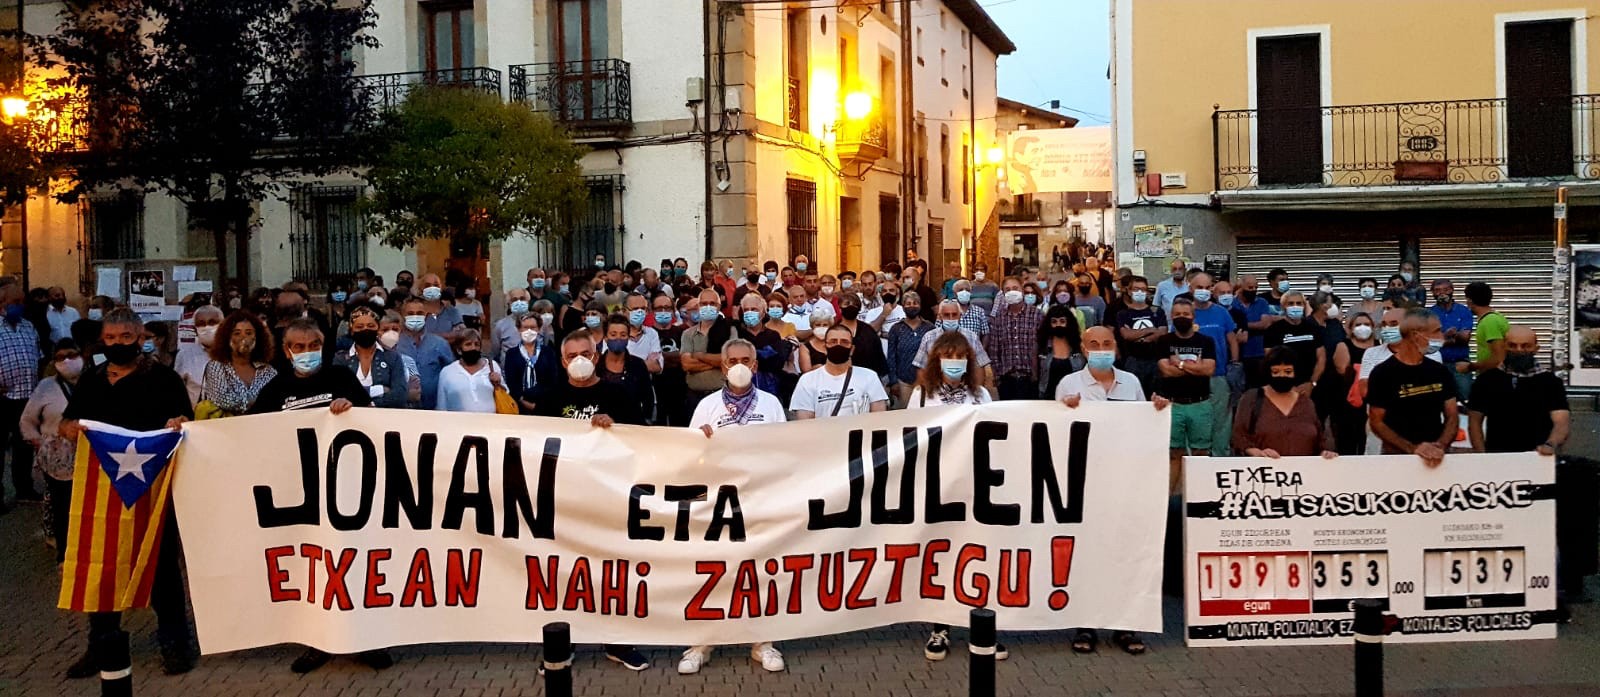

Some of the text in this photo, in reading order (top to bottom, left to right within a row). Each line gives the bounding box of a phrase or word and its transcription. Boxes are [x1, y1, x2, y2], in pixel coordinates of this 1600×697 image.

[253, 420, 1091, 542] JONAN ETA JULEN
[1216, 466, 1303, 488] ETXERA
[1219, 480, 1533, 518] #ALTSASUKOAKASKE
[264, 543, 483, 611] ETXEAN
[1244, 600, 1271, 613] egun
[1466, 595, 1483, 607] km
[1273, 620, 1335, 636] POLIZIALIK
[1403, 613, 1532, 632] MONTAJES POLICIALES
